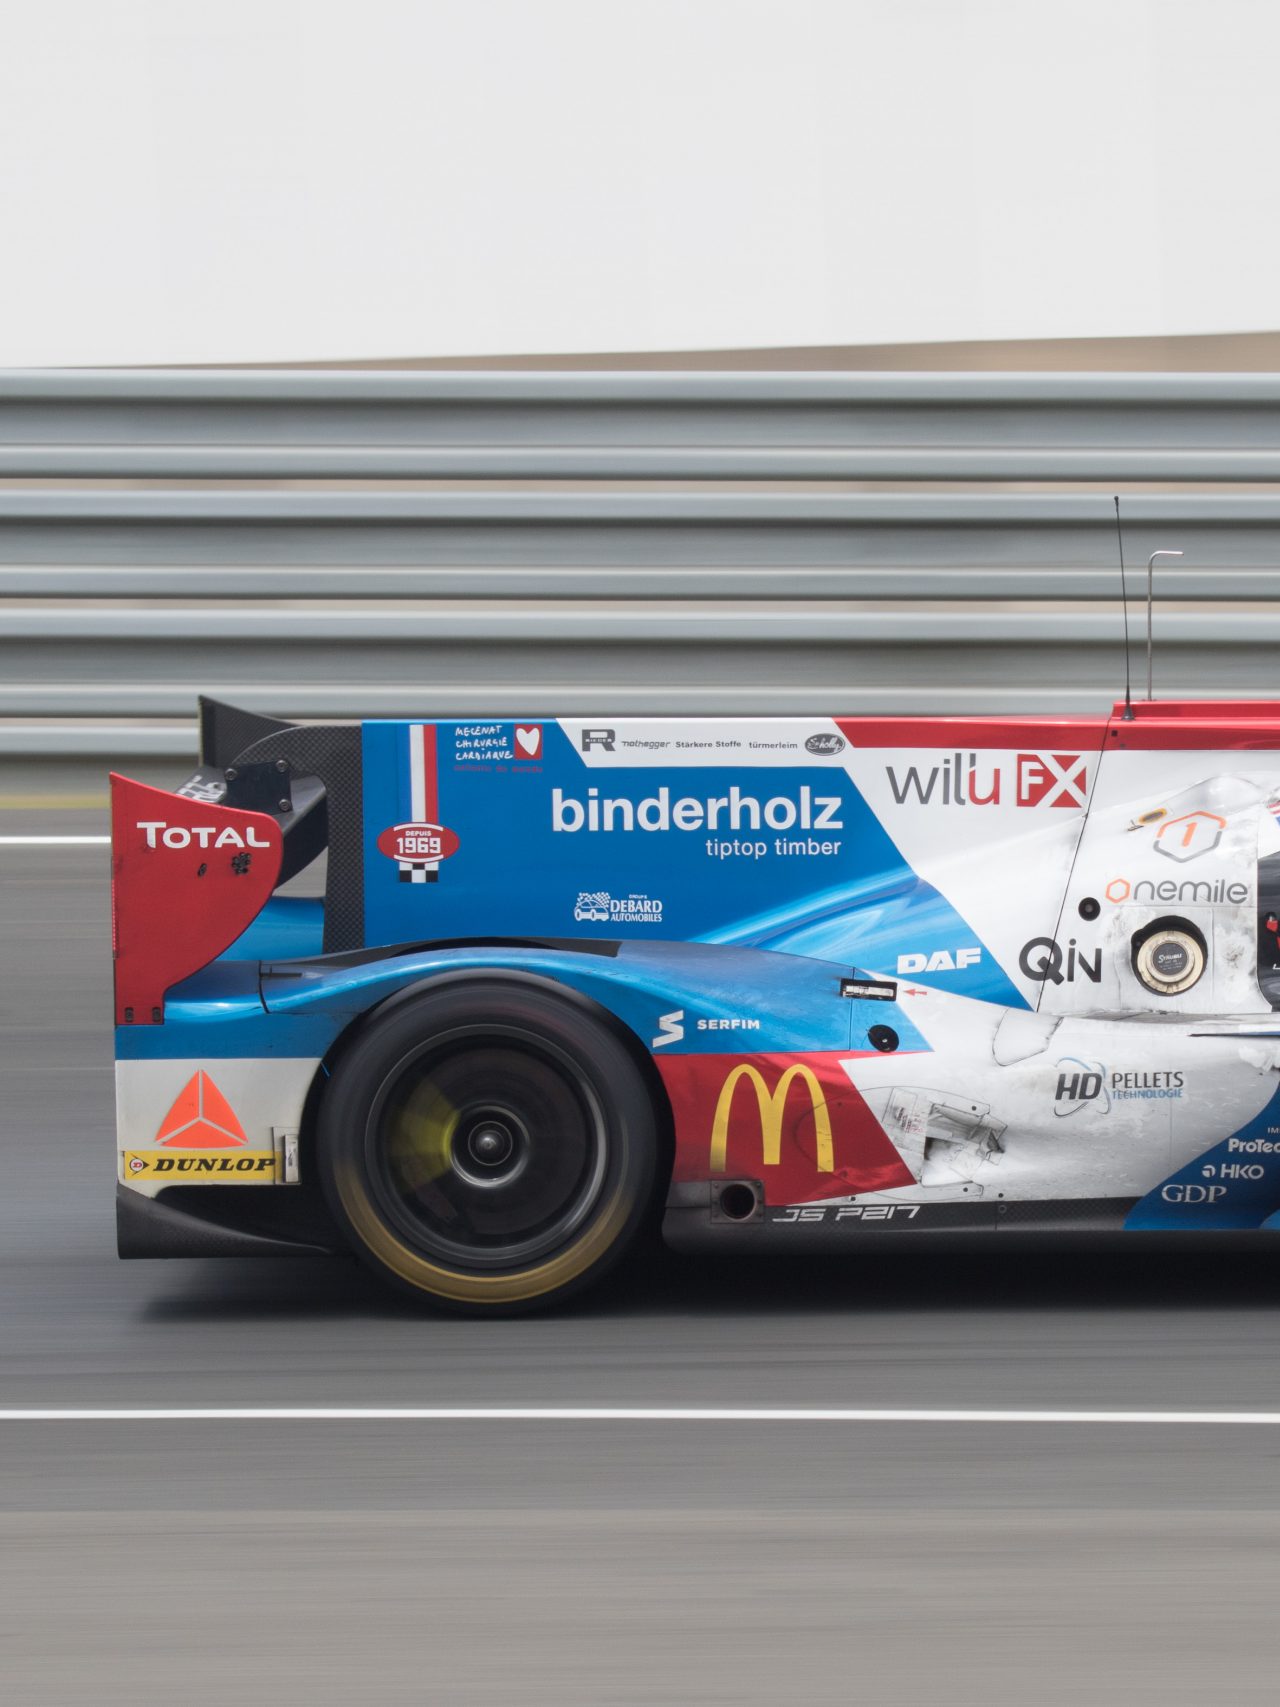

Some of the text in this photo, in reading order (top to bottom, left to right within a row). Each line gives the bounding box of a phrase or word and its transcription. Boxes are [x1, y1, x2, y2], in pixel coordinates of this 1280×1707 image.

[675, 740, 742, 748] Stärkere Stoffe
[749, 741, 798, 749] türmerleim
[455, 749, 514, 761] CARDIAQUE
[1016, 753, 1087, 808] FX
[552, 786, 843, 832] binderholz
[136, 822, 270, 849] TOTAL
[396, 837, 441, 854] 1969
[706, 838, 842, 860] tiptop timber
[1105, 879, 1248, 904] onemile
[610, 899, 663, 913] DEBARD
[610, 913, 663, 922] AUTOMOBILES
[897, 947, 981, 974] DAF
[697, 1019, 760, 1030] SERFIM
[1055, 1072, 1184, 1100] HD PELLETS
[1112, 1088, 1184, 1100] TECHNOLOGIE
[153, 1158, 276, 1172] DUNLOP
[1220, 1163, 1265, 1180] HKO
[1161, 1184, 1227, 1204] GDP
[772, 1205, 920, 1223] JS P217
